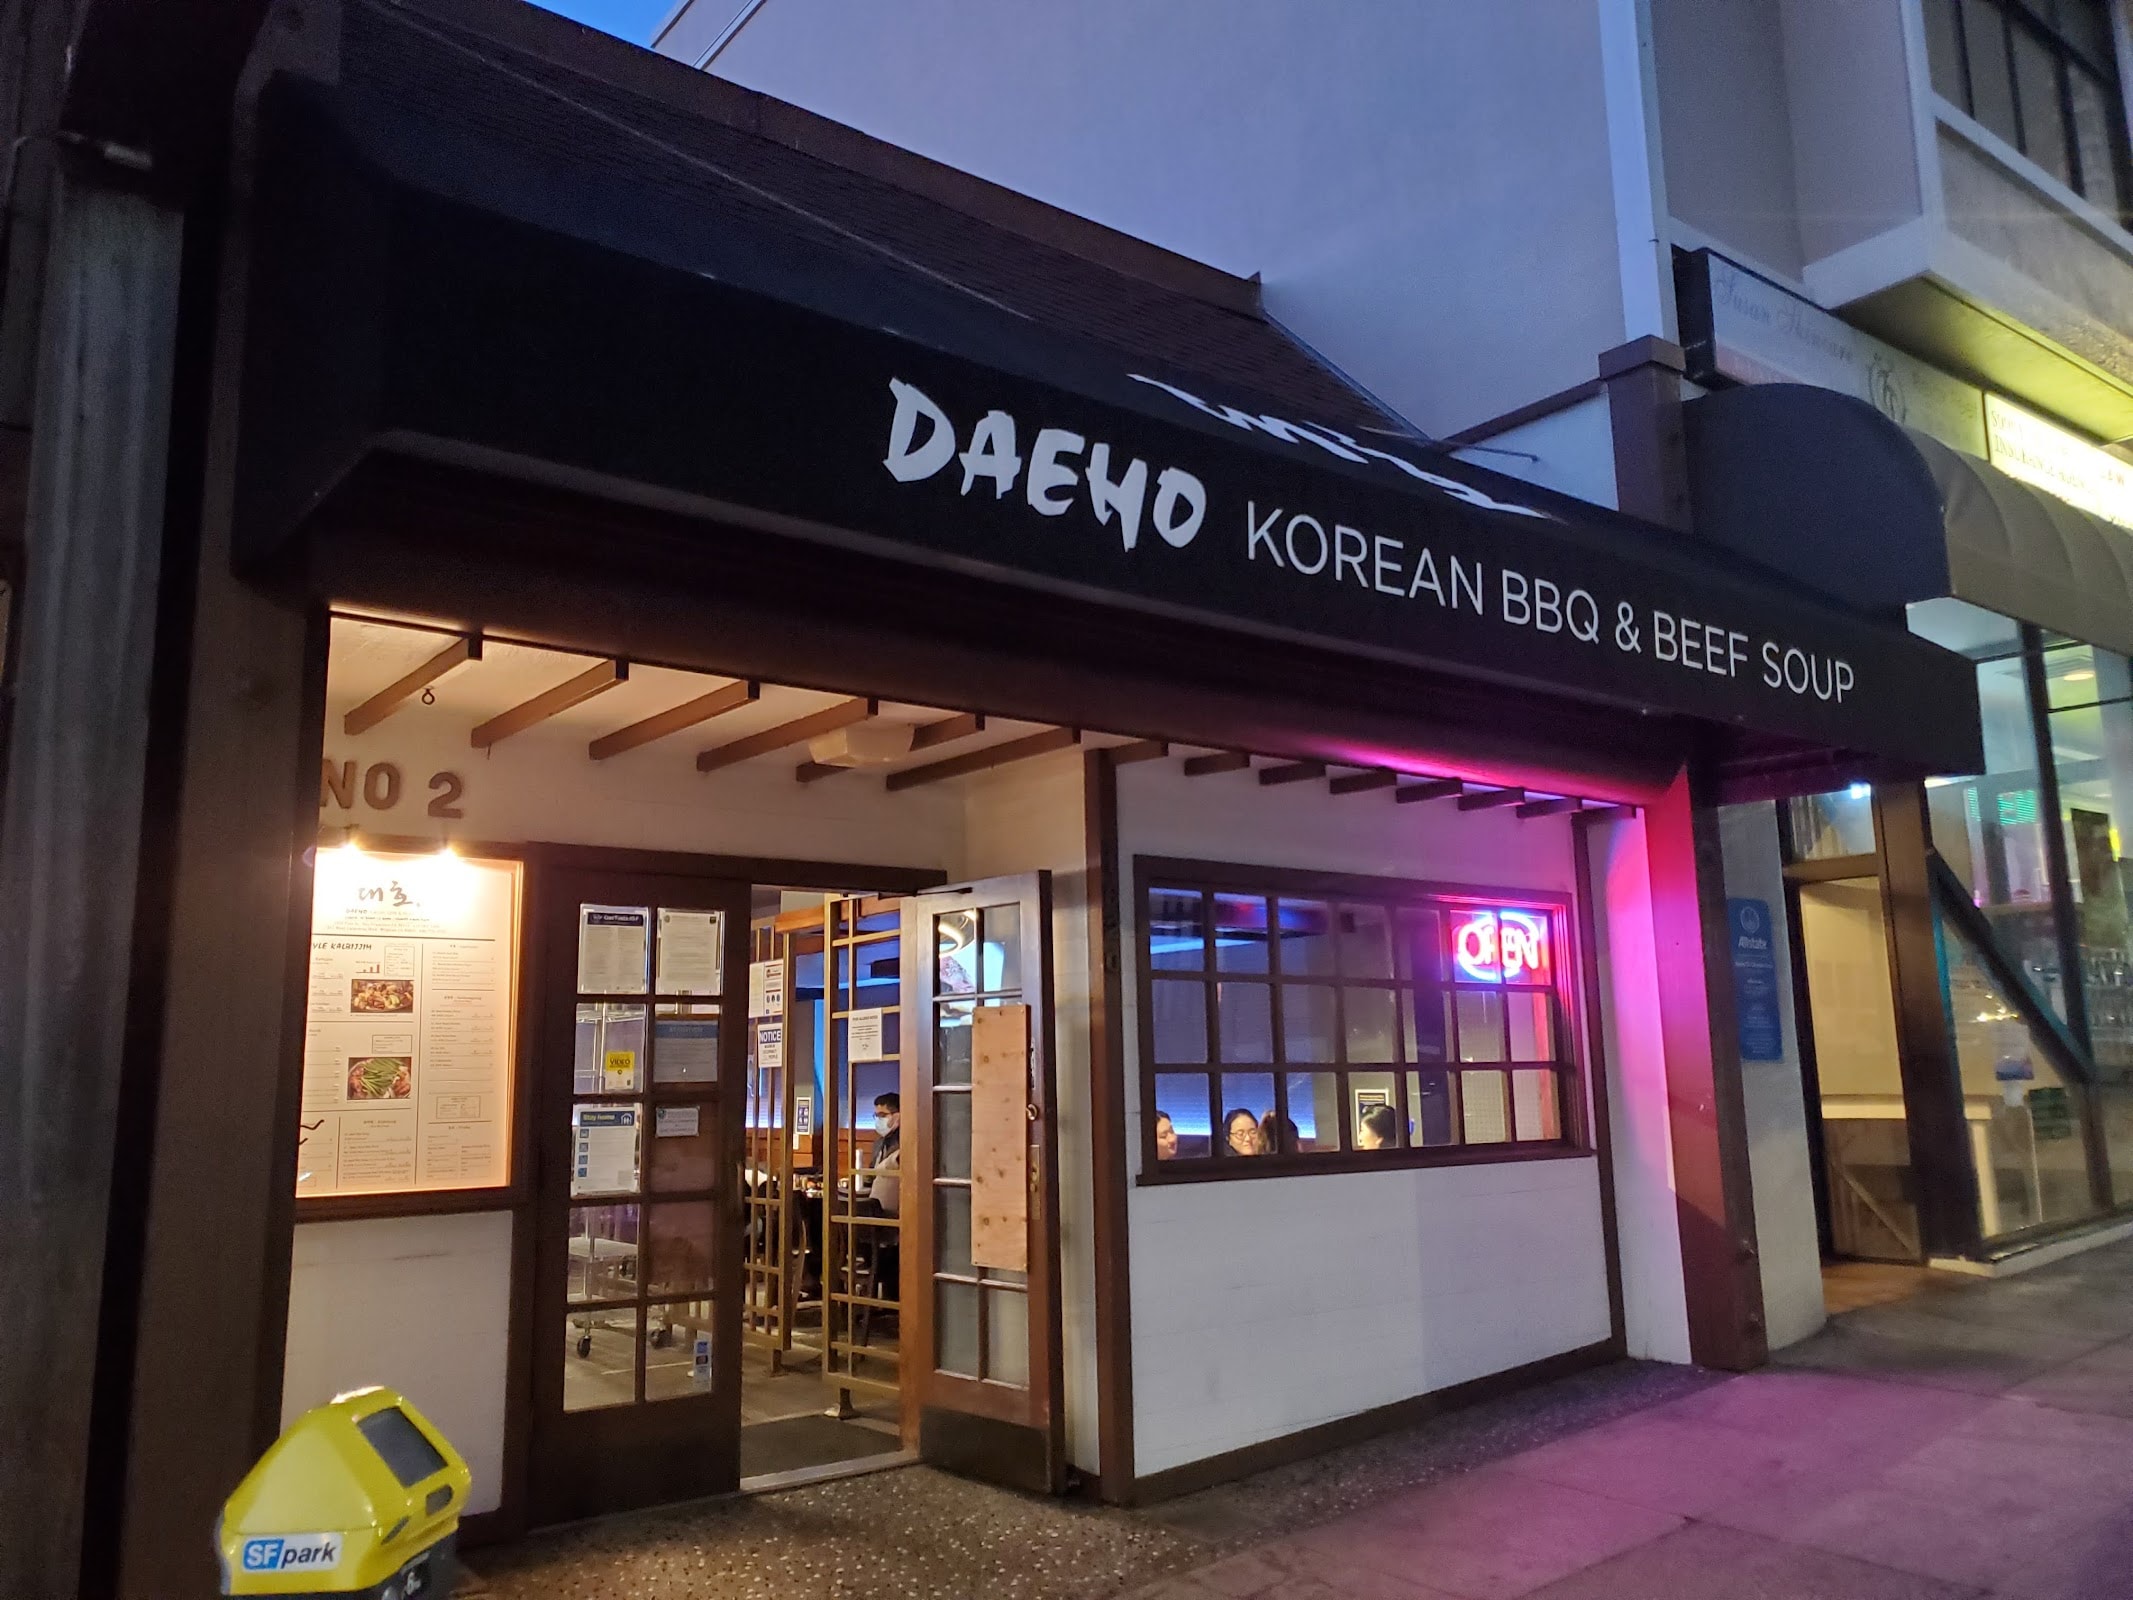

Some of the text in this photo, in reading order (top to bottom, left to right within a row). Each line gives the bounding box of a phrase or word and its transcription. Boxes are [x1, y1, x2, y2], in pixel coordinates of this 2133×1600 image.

[882, 376, 1855, 703] DAEHO KOREAN BBQ & BEEF SOUP
[320, 758, 465, 819] NO 2
[312, 942, 329, 950] YLE
[1457, 922, 1540, 970] OPEN
[760, 1028, 781, 1042] NOTICE
[609, 1058, 631, 1066] VIDEO
[246, 1541, 336, 1569] SFpark
